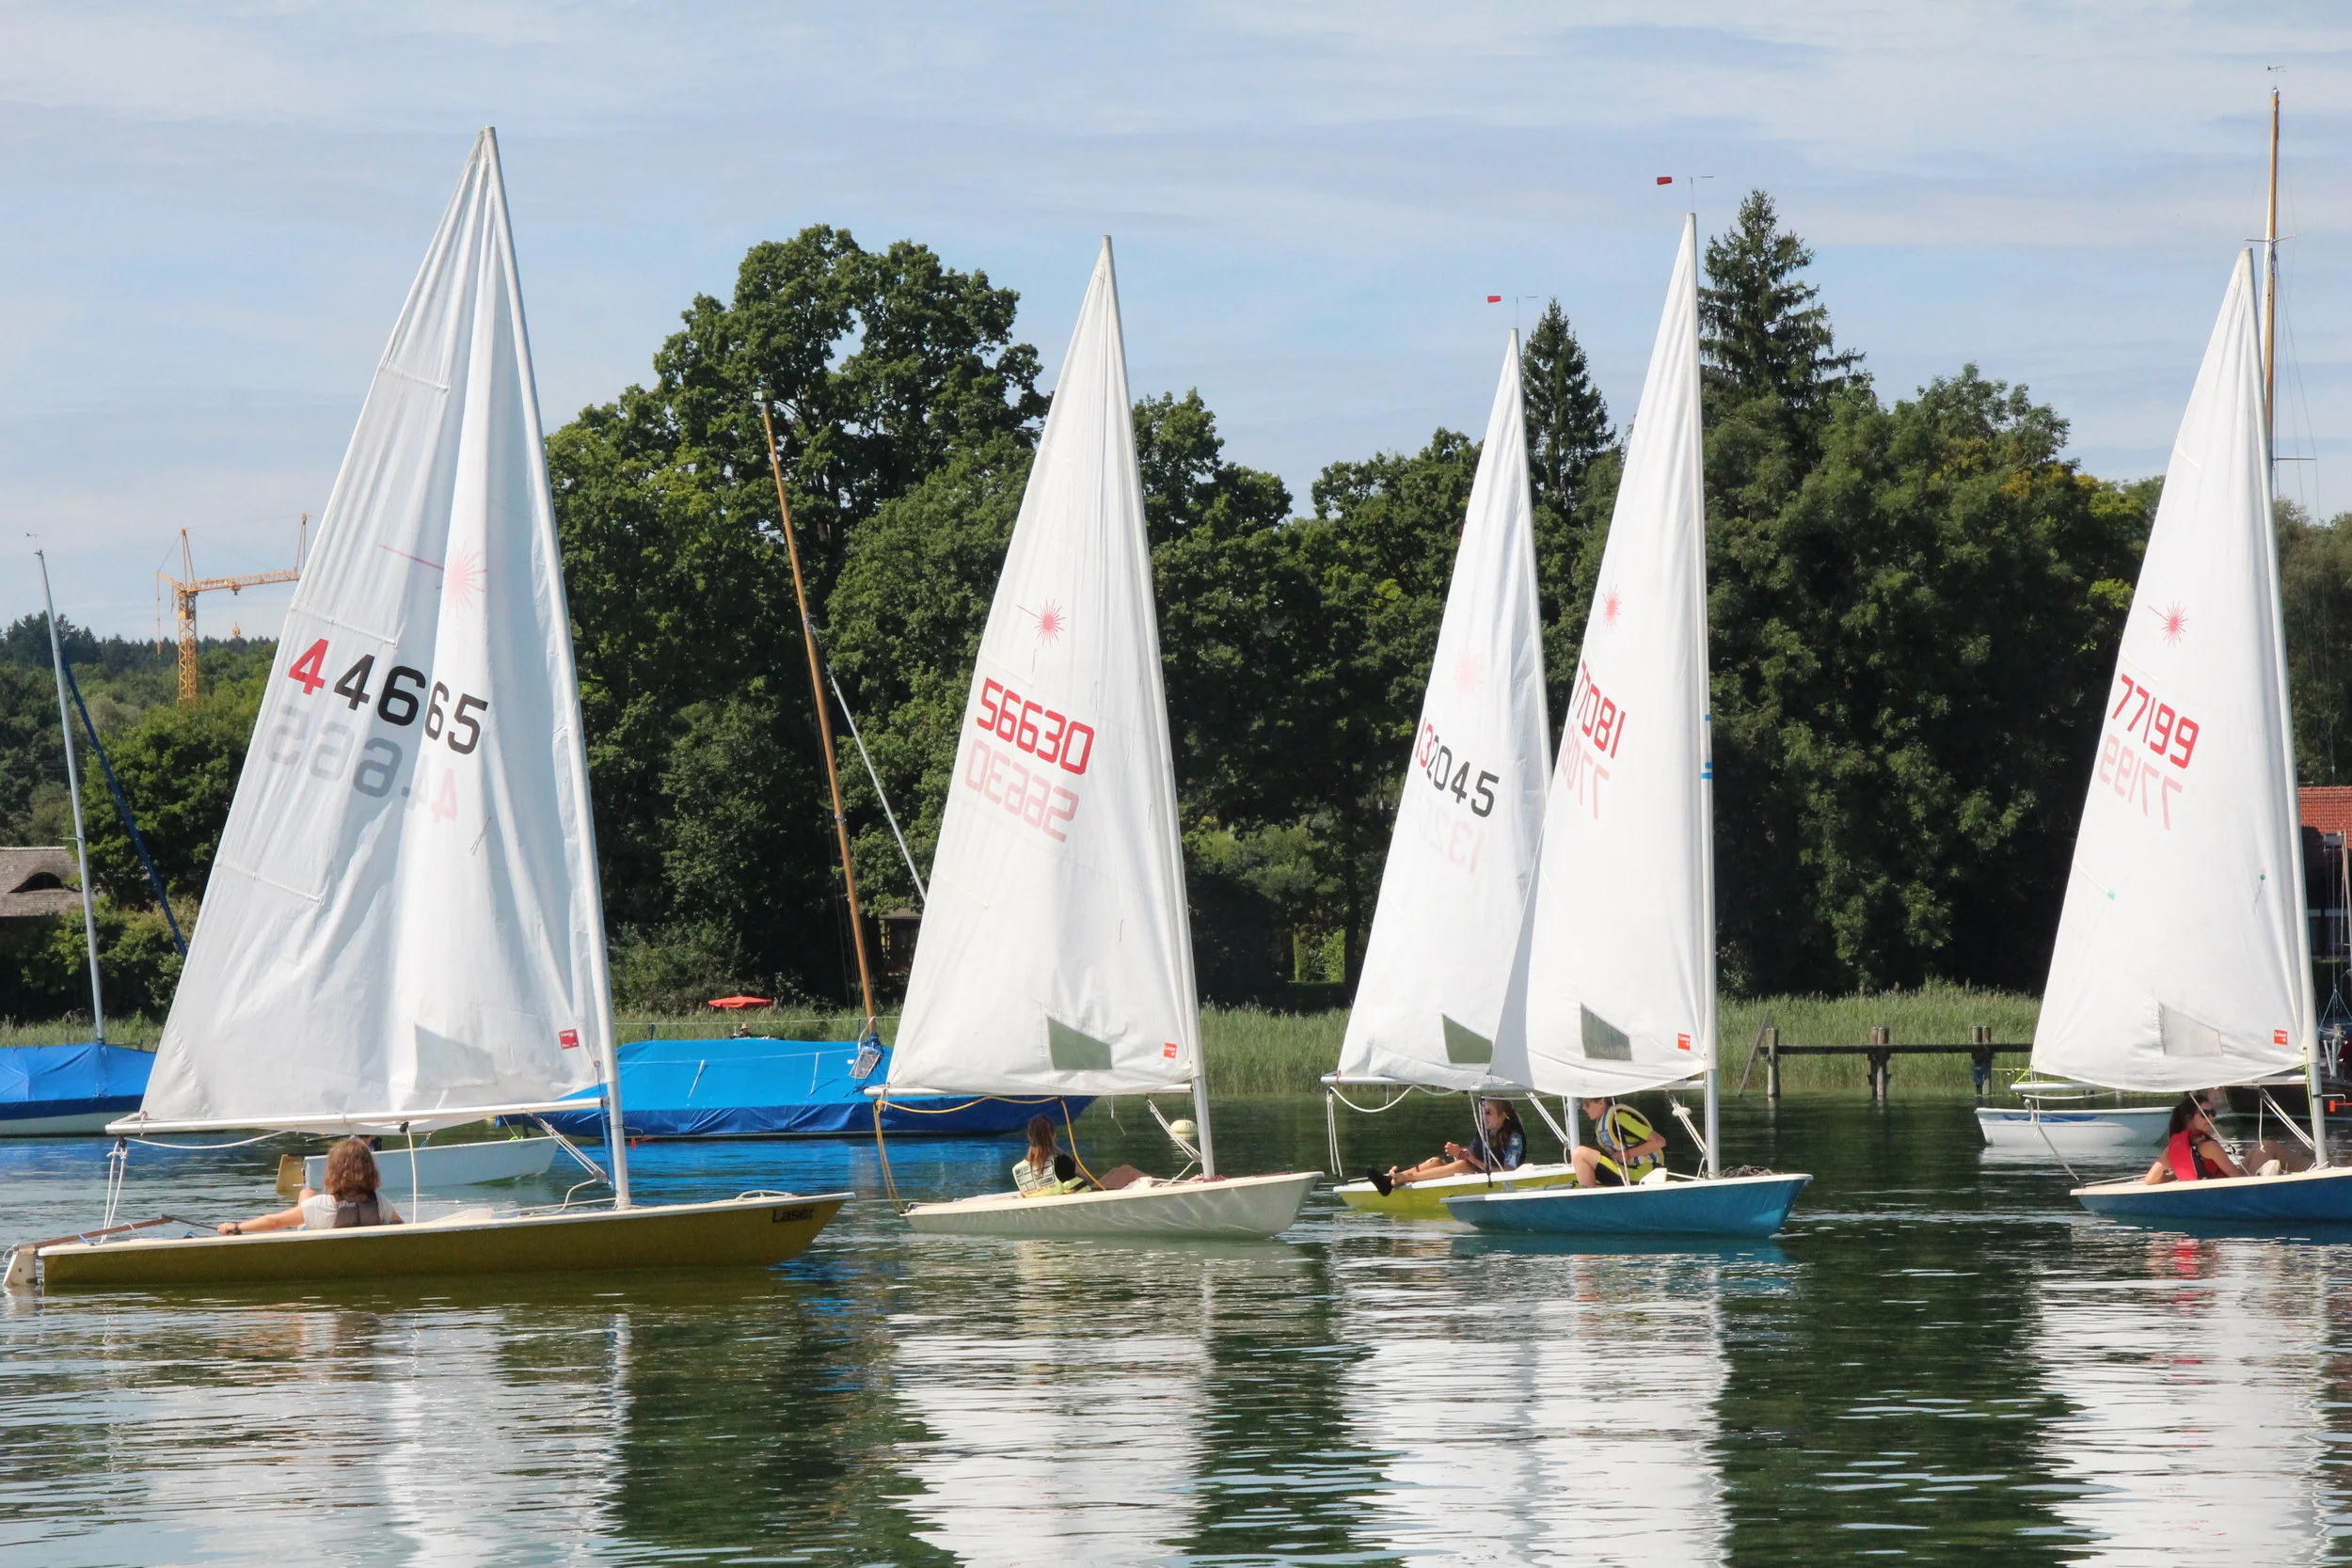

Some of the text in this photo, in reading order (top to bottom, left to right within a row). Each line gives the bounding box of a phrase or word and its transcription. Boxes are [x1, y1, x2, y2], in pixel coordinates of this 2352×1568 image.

[288, 639, 488, 753] 44665
[977, 678, 1095, 774] 56630
[2113, 673, 2200, 768] 77199
[771, 1207, 815, 1223] Laser
